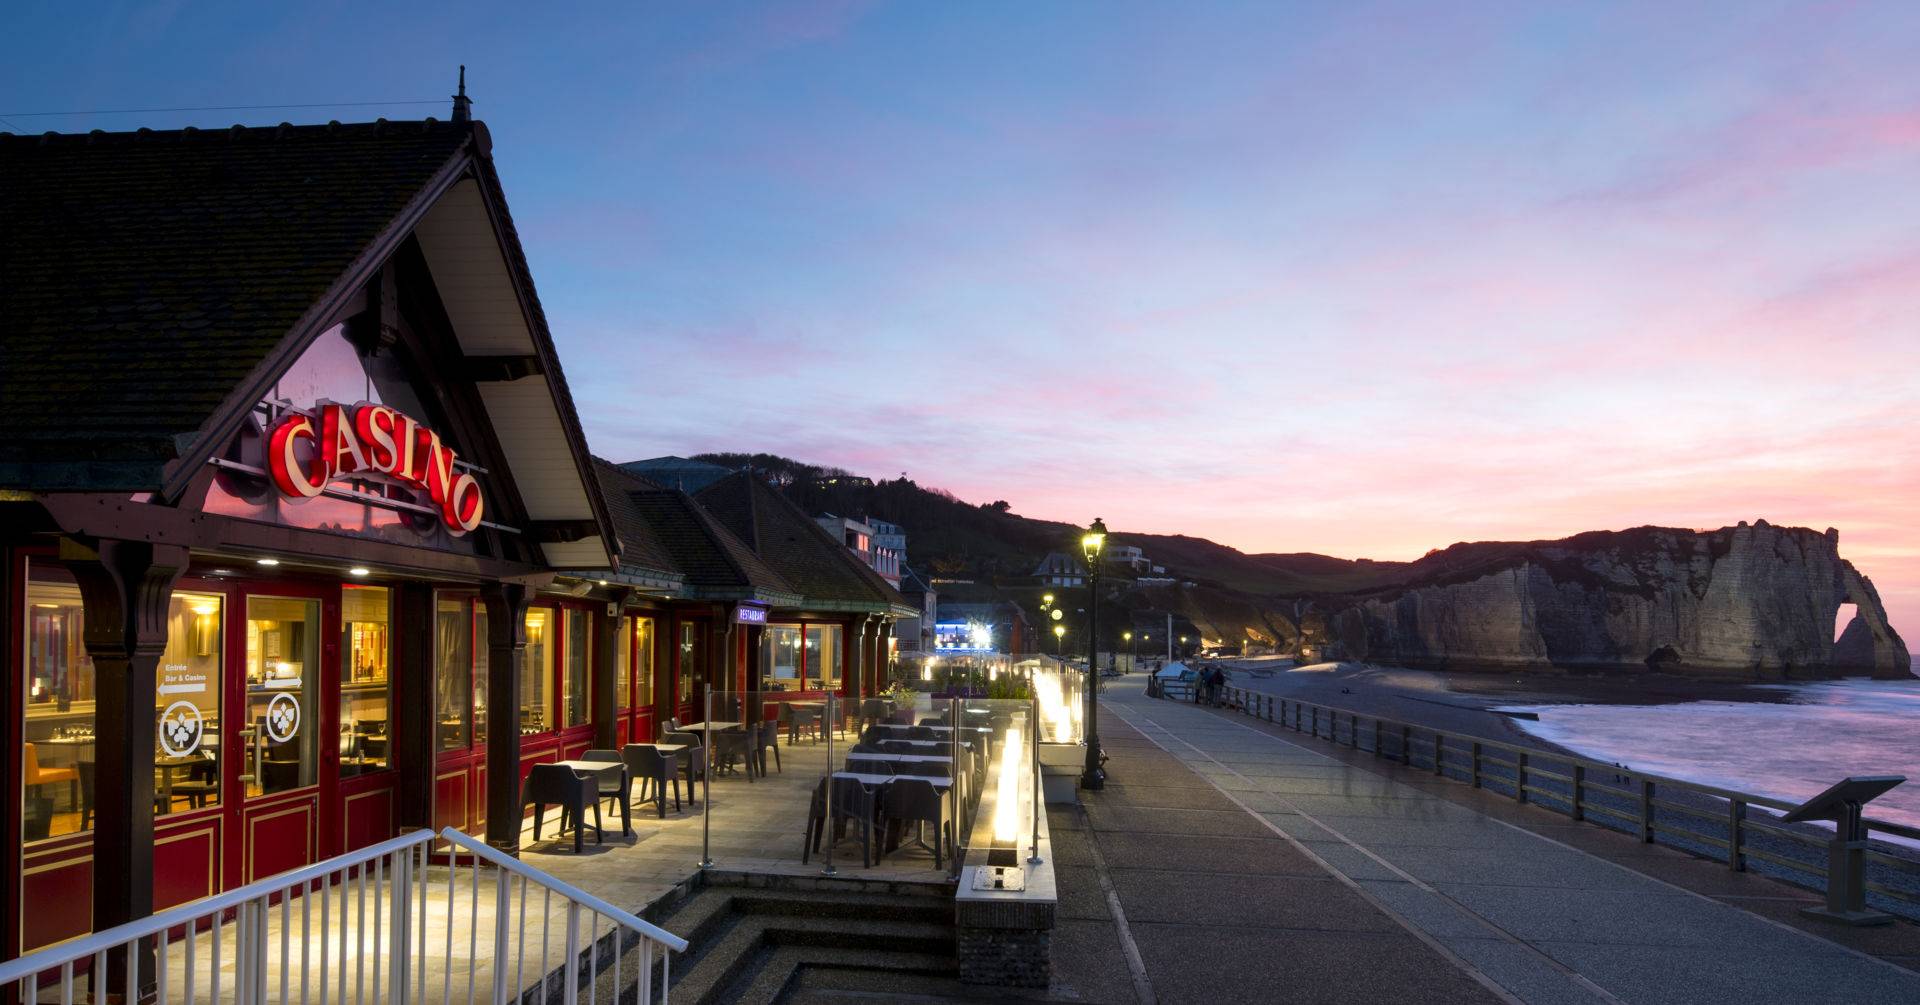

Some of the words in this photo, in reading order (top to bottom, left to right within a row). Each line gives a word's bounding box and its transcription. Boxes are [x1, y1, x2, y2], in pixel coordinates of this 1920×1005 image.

[268, 405, 484, 532] CASINO
[740, 609, 765, 621] RESTAURANT
[165, 664, 187, 672] Entrée
[165, 674, 177, 682] Bar
[178, 674, 184, 682] &
[184, 673, 207, 681] Casino
